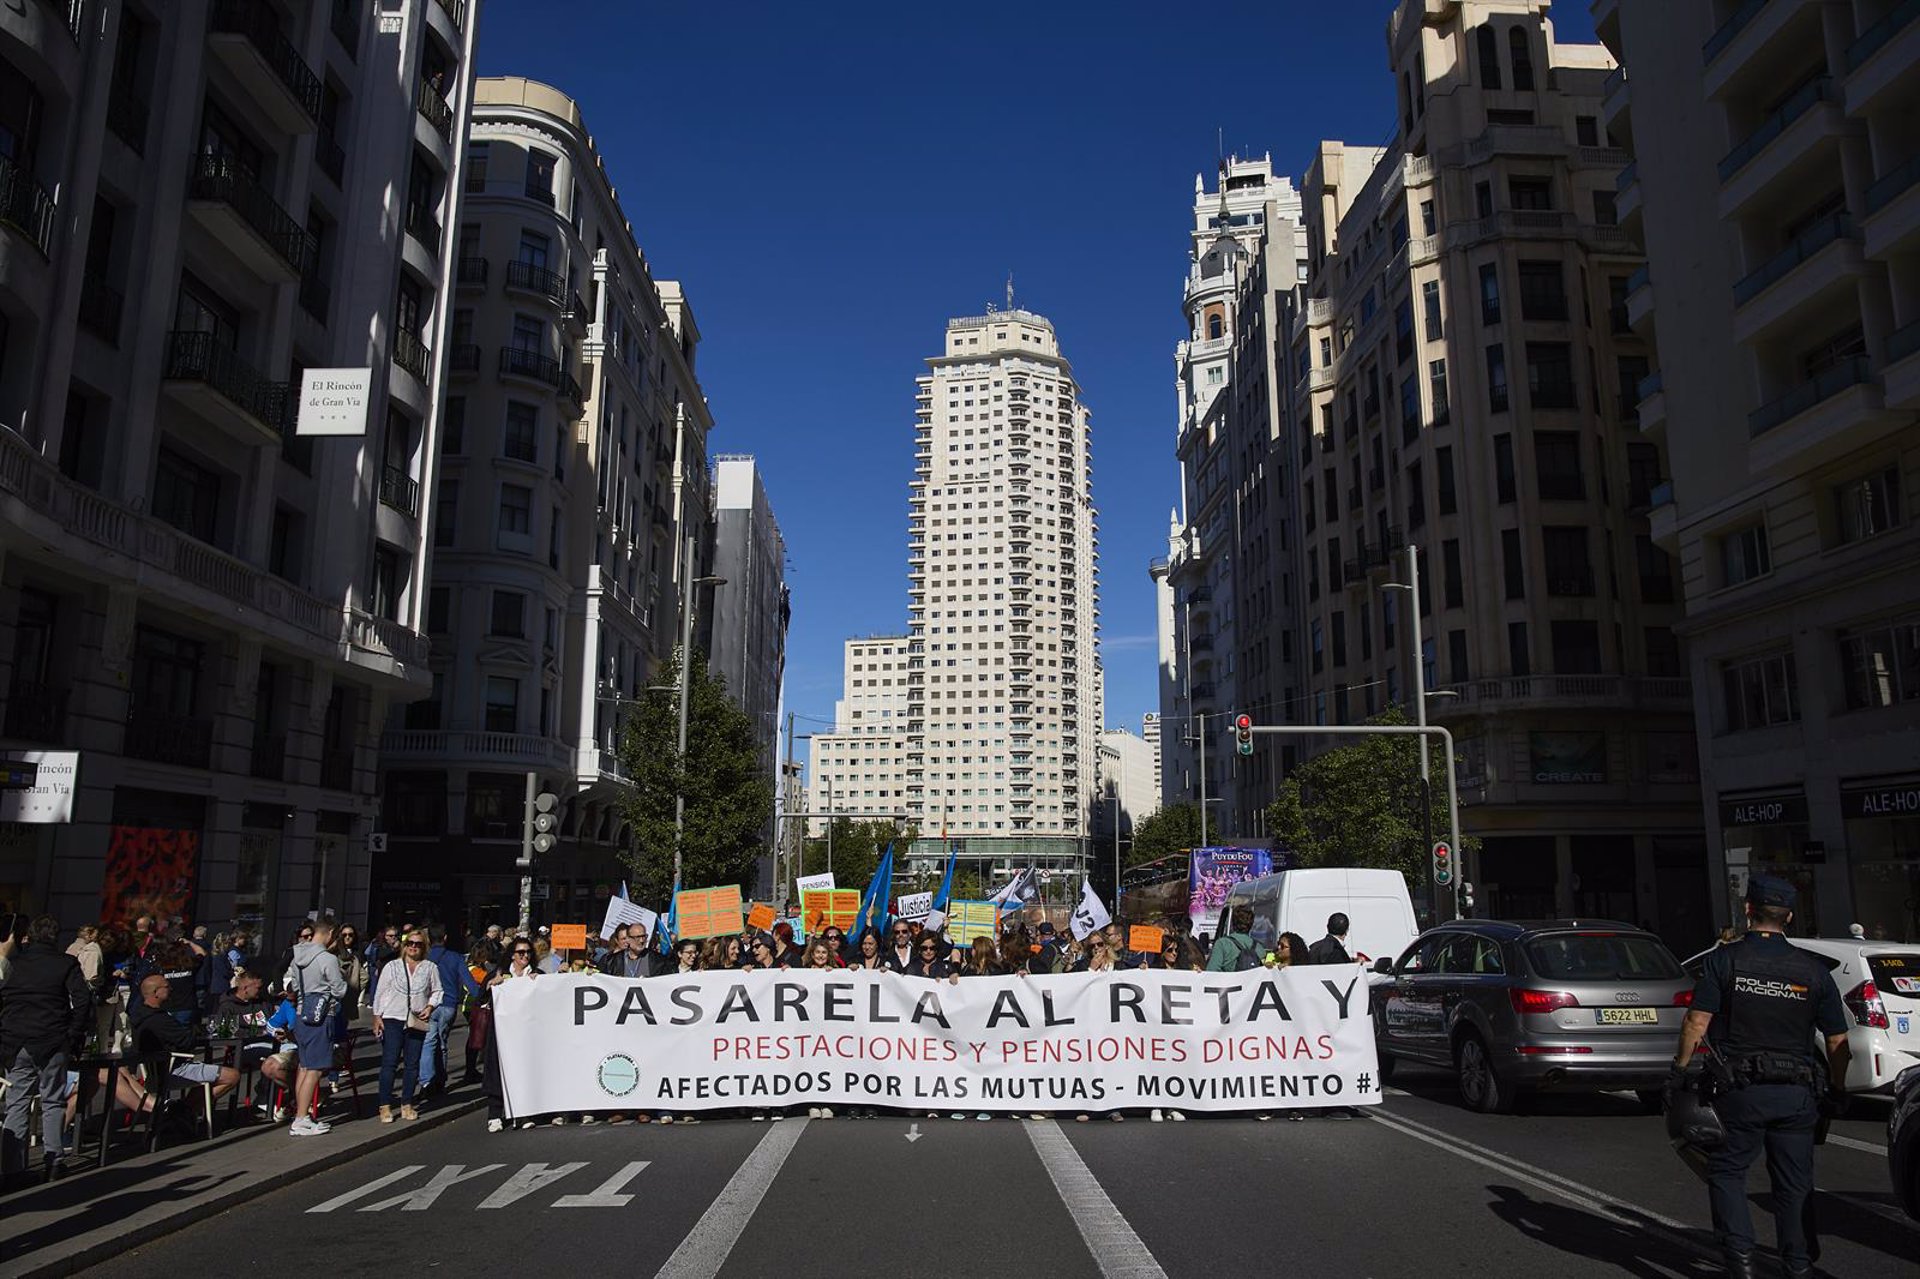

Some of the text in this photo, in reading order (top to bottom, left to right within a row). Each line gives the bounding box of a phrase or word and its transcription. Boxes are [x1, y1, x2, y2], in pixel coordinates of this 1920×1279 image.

[312, 380, 362, 390] El Rincón
[309, 397, 320, 406] de
[322, 397, 344, 406] Gran
[39, 763, 73, 774] incón
[1536, 772, 1605, 782] CREATE
[1735, 802, 1784, 823] ALE-HOP
[1735, 976, 1793, 991] POLICIA
[1735, 983, 1807, 1001] NACIONAL
[574, 976, 1359, 1030] PASARELA AL RETA Y
[1603, 1009, 1655, 1021] 5622 HHL
[713, 1034, 1334, 1063] PRESTACIONES Y PENSIONES DIGNAS
[658, 1072, 832, 1099] AFECTADOS
[845, 1072, 902, 1098] POR
[914, 1076, 968, 1099] LAS
[982, 1077, 1105, 1100] MUTUAS
[1137, 1073, 1343, 1100] MOVIMIENTO
